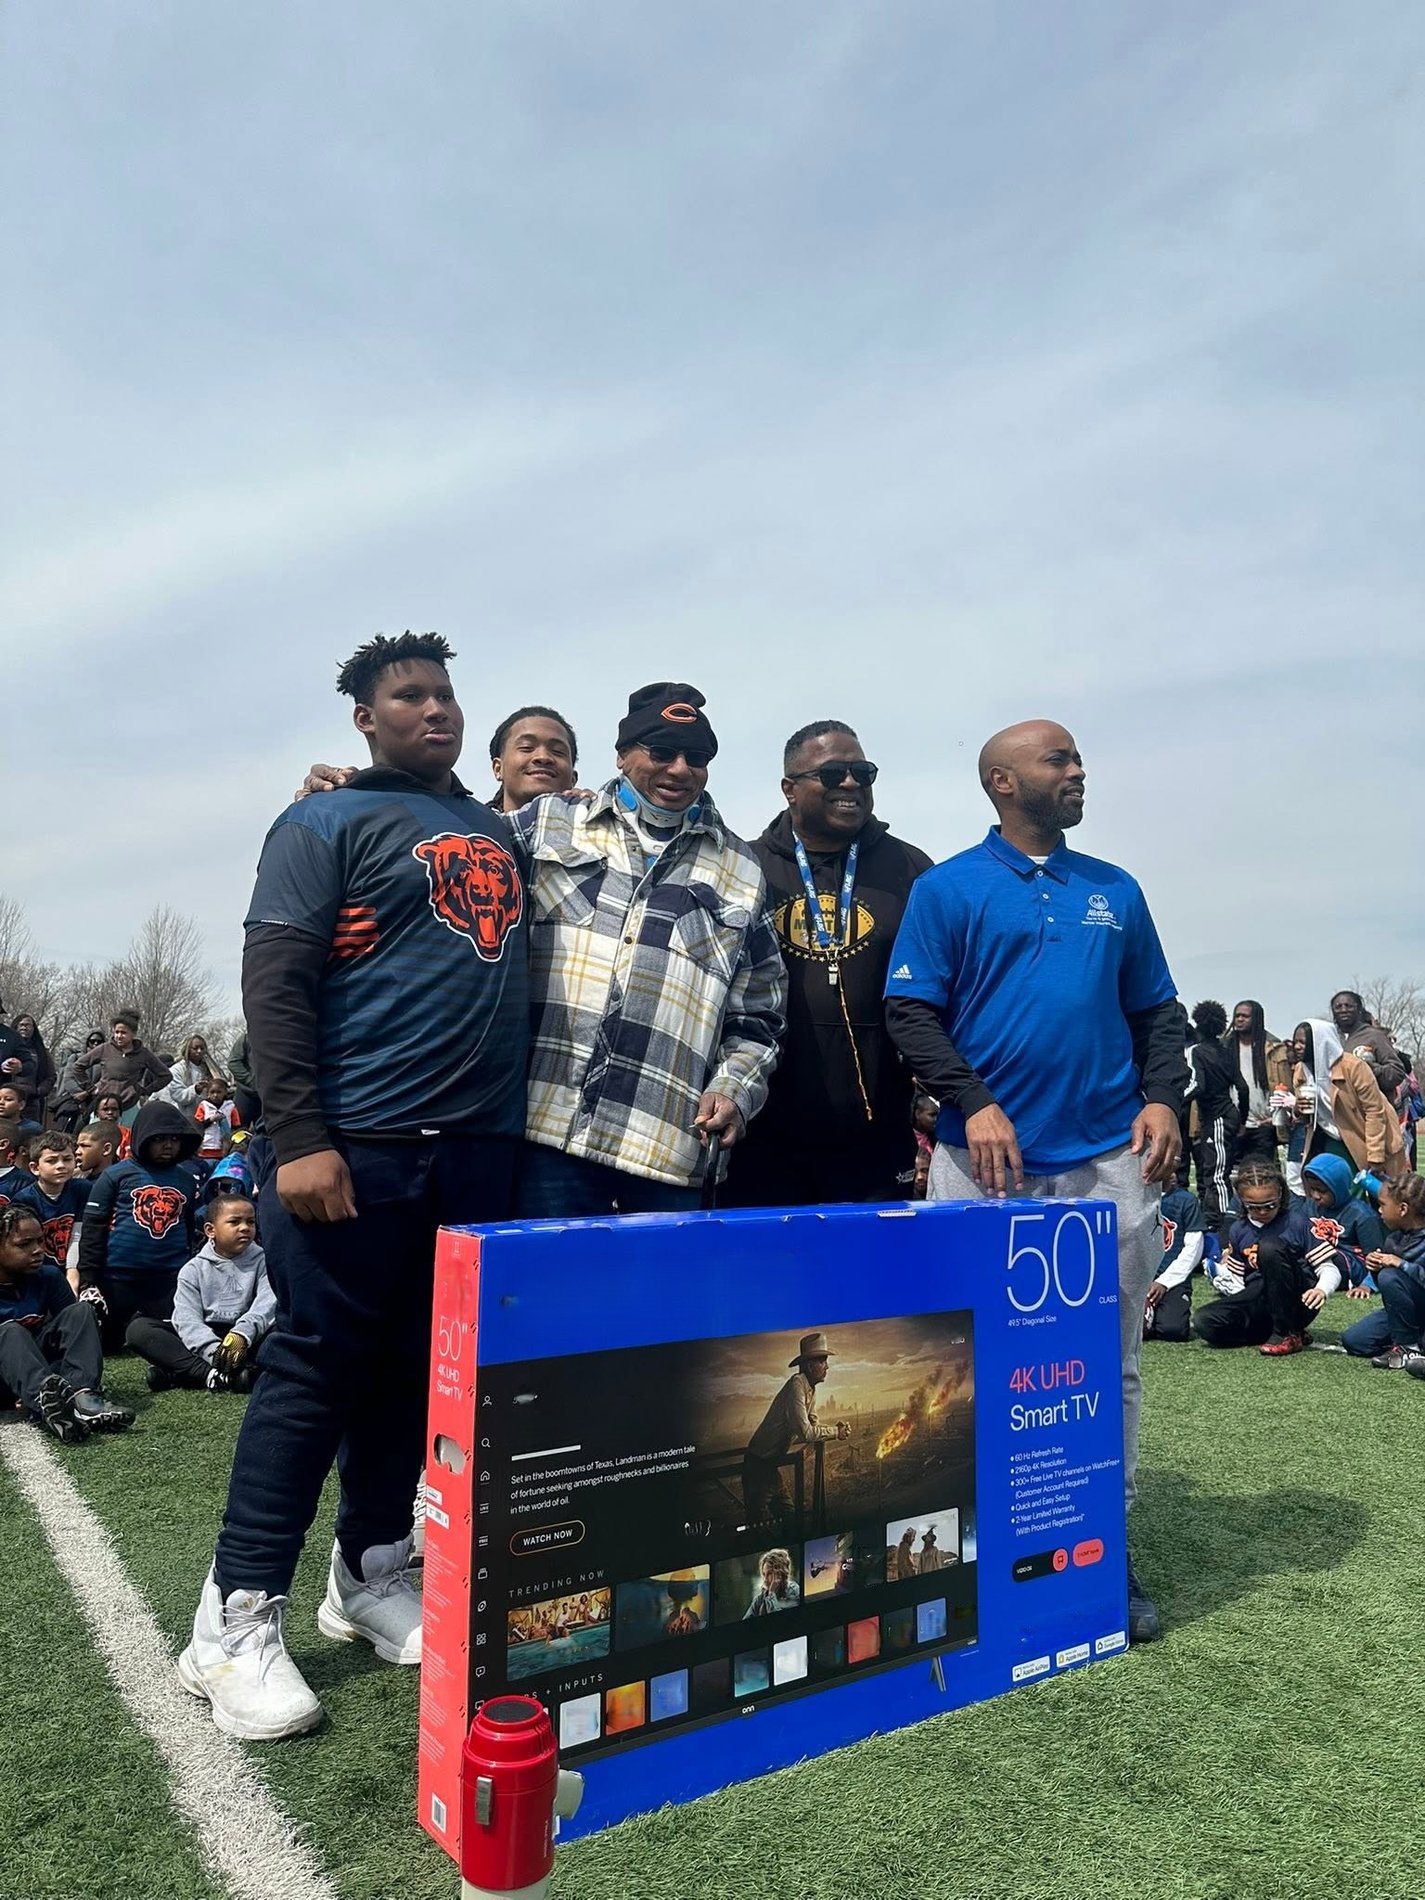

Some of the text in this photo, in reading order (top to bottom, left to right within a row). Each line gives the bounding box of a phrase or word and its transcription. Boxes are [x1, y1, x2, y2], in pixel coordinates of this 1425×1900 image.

[1007, 1210, 1111, 1312] 50"
[1098, 1295, 1118, 1304] CLASS
[1022, 1316, 1045, 1326] Diagonal
[1045, 1315, 1057, 1323] Size
[438, 1315, 468, 1361] 50"
[445, 1367, 460, 1383] UHD
[1009, 1360, 1085, 1393] 4K UHD
[436, 1380, 463, 1401] Smart TV
[1010, 1391, 1099, 1431] Smart TV
[1015, 1446, 1064, 1461] 60 Hz Refresh Rate
[511, 1474, 524, 1485] Set
[524, 1473, 532, 1482] in
[532, 1471, 545, 1480] the
[545, 1464, 586, 1478] boomtowns
[586, 1462, 594, 1471] of
[595, 1460, 615, 1469] Texas,
[615, 1454, 646, 1466] Landman
[647, 1452, 653, 1460] is
[658, 1448, 683, 1458] modern
[683, 1445, 696, 1454] tale
[1015, 1465, 1032, 1474] 2160p
[1040, 1458, 1067, 1469] Resolution
[510, 1460, 689, 1500] of fortune seeking amongst roughnecks and billionaires
[1015, 1478, 1030, 1486] 300+
[1030, 1475, 1042, 1484] Free
[1042, 1473, 1053, 1481] Live
[1062, 1467, 1085, 1477] channels
[1015, 1476, 1089, 1500] (Customer Account Required)
[510, 1496, 570, 1515] in the world of oil.
[1015, 1494, 1071, 1512] Quick and Easy Setup
[1032, 1509, 1052, 1520] Limited
[1052, 1504, 1076, 1516] Warranty
[1031, 1521, 1052, 1533] Product
[522, 1528, 573, 1547] WATCH NOW
[509, 1569, 605, 1598] TRENDING NOW
[559, 1673, 604, 1692] INPUTS
